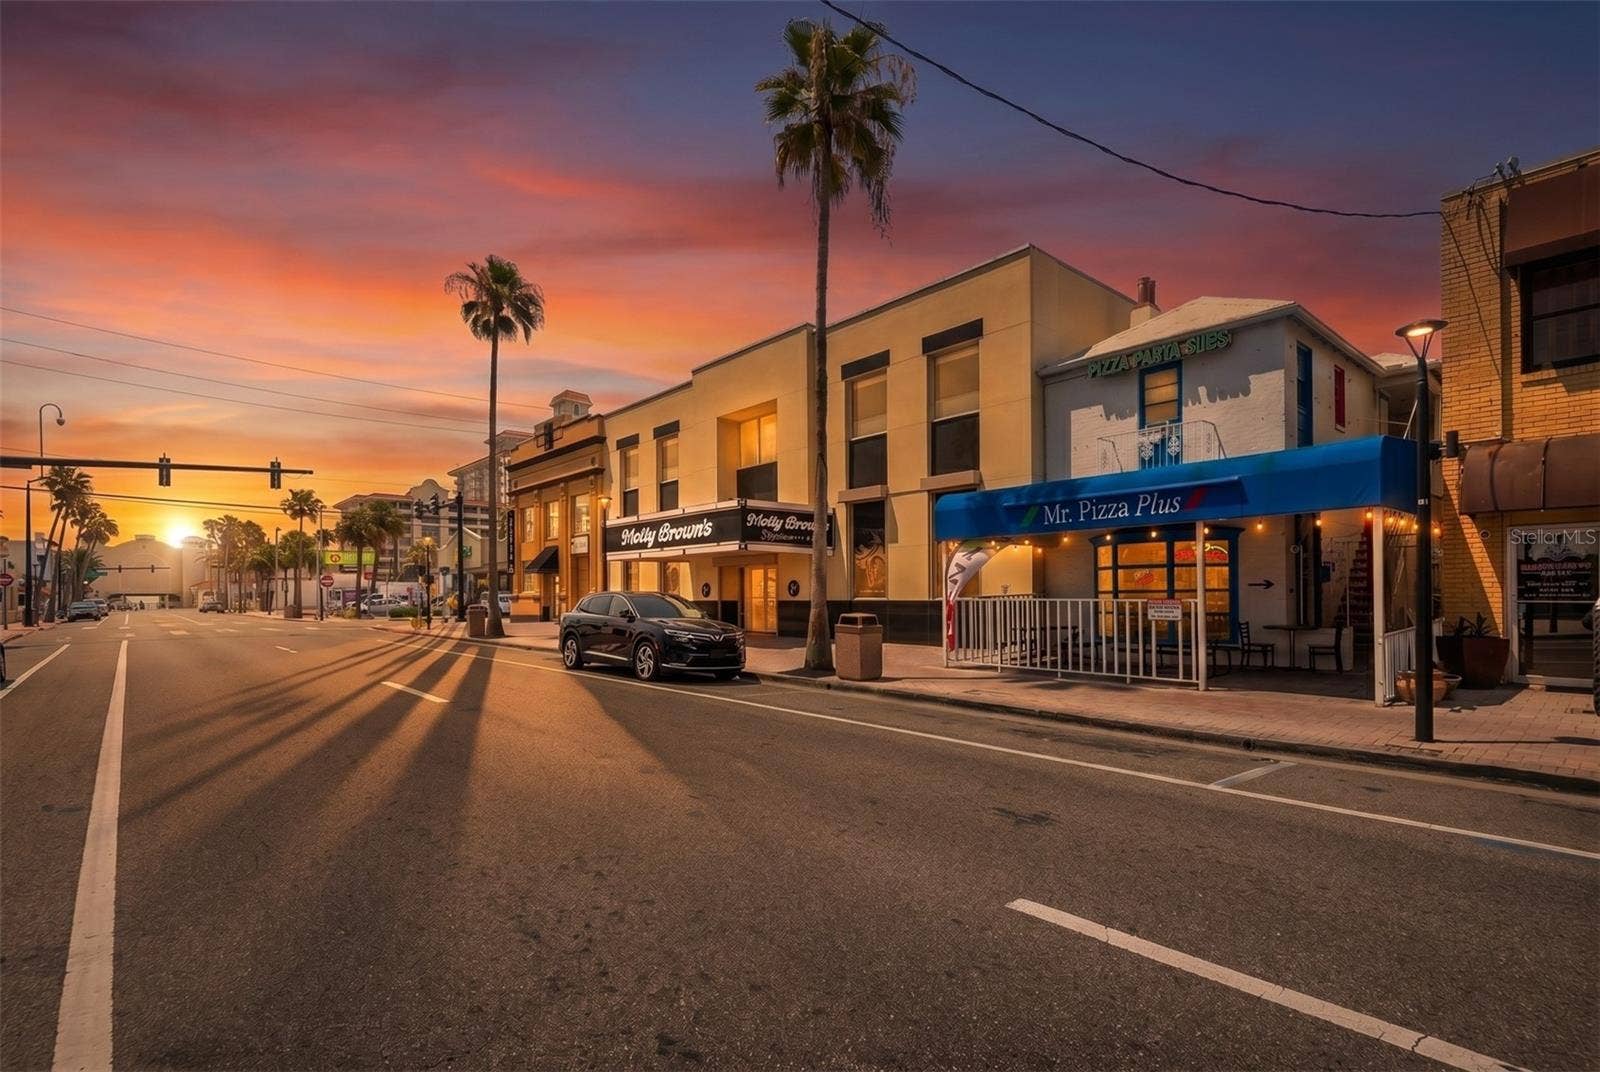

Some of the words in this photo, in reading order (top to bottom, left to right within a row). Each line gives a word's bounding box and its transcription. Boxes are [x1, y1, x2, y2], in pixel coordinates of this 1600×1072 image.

[1087, 354, 1129, 378] PIZZA
[746, 513, 783, 531] Molly
[1043, 504, 1072, 525] Mr.
[1079, 499, 1130, 521] Pizza
[1134, 493, 1181, 517] Plus
[621, 527, 656, 548] Molly
[657, 518, 713, 542] Brown's
